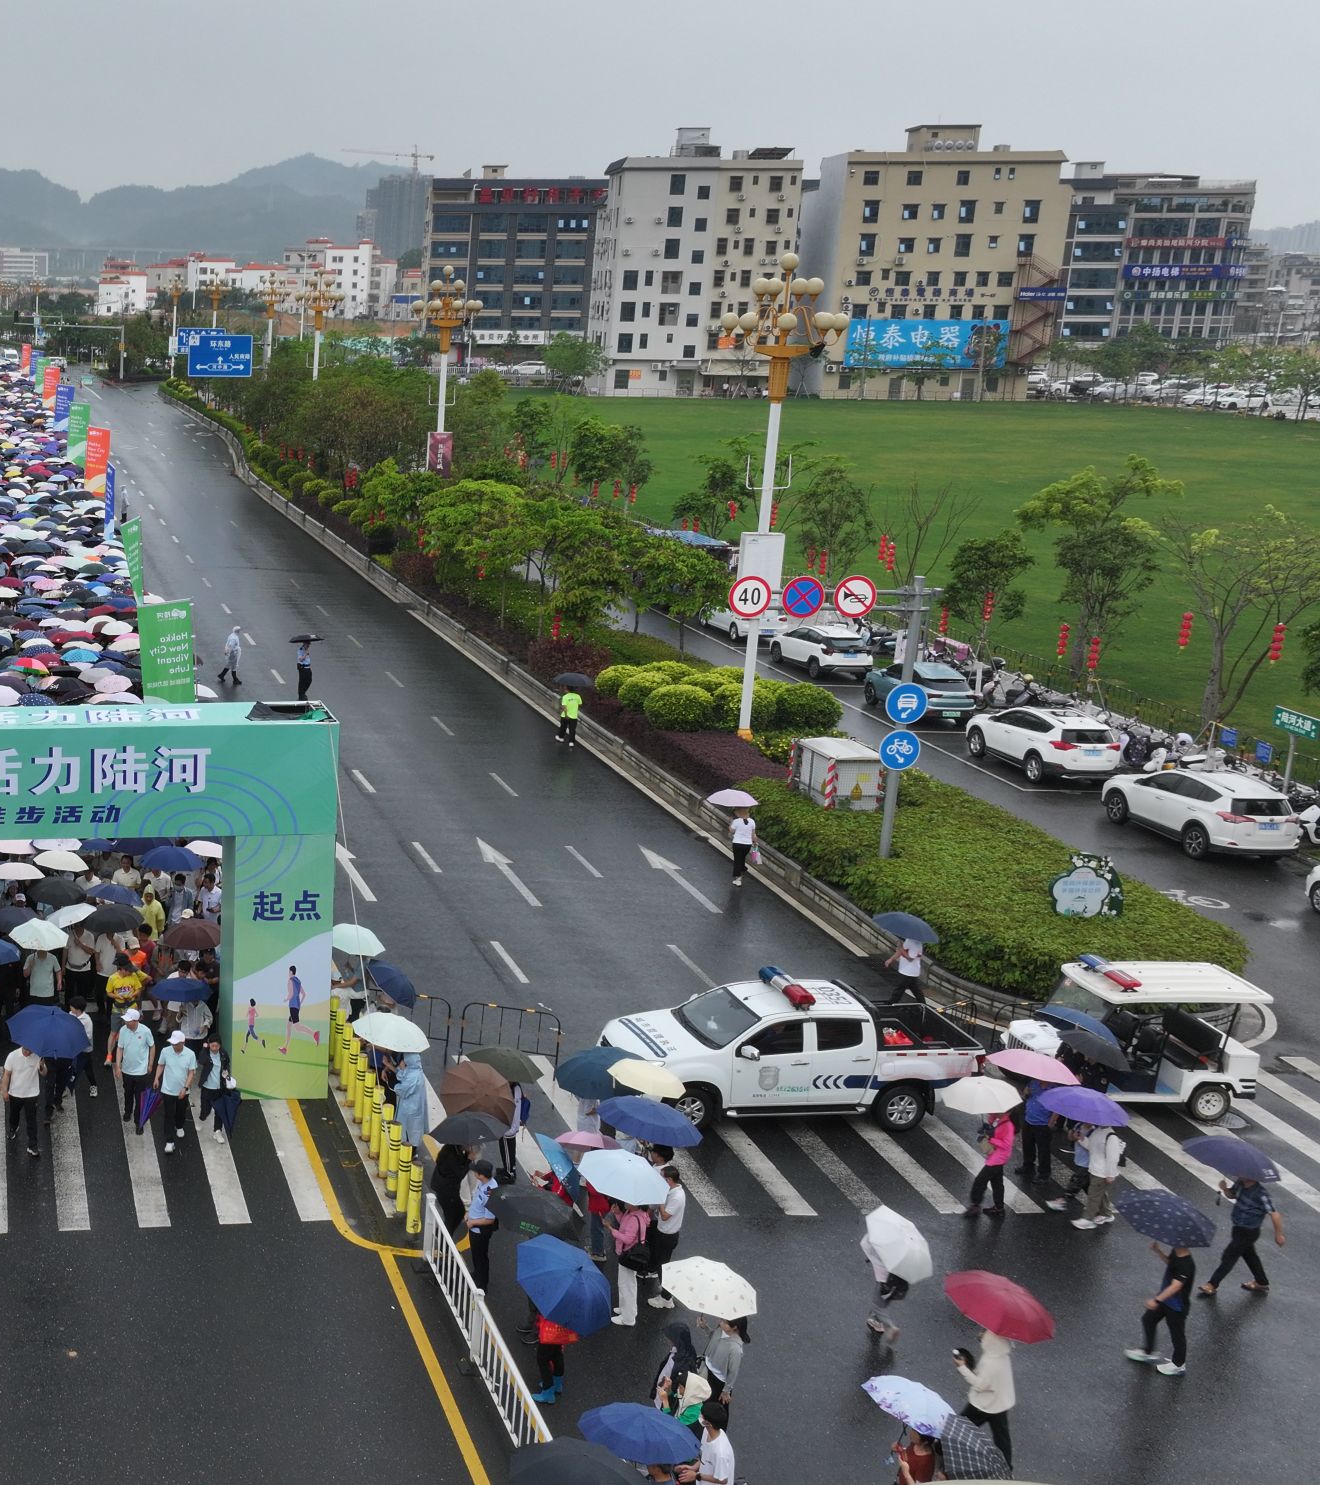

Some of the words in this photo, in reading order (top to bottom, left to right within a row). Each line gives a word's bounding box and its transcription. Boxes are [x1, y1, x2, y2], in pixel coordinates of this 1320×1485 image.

[1142, 266, 1180, 277] 中扬电梯
[210, 340, 232, 349] 环东路
[852, 323, 961, 350] 恒泰电器
[738, 587, 761, 606] 40
[1280, 712, 1312, 732] 陆河大道
[252, 889, 322, 922] 起点
